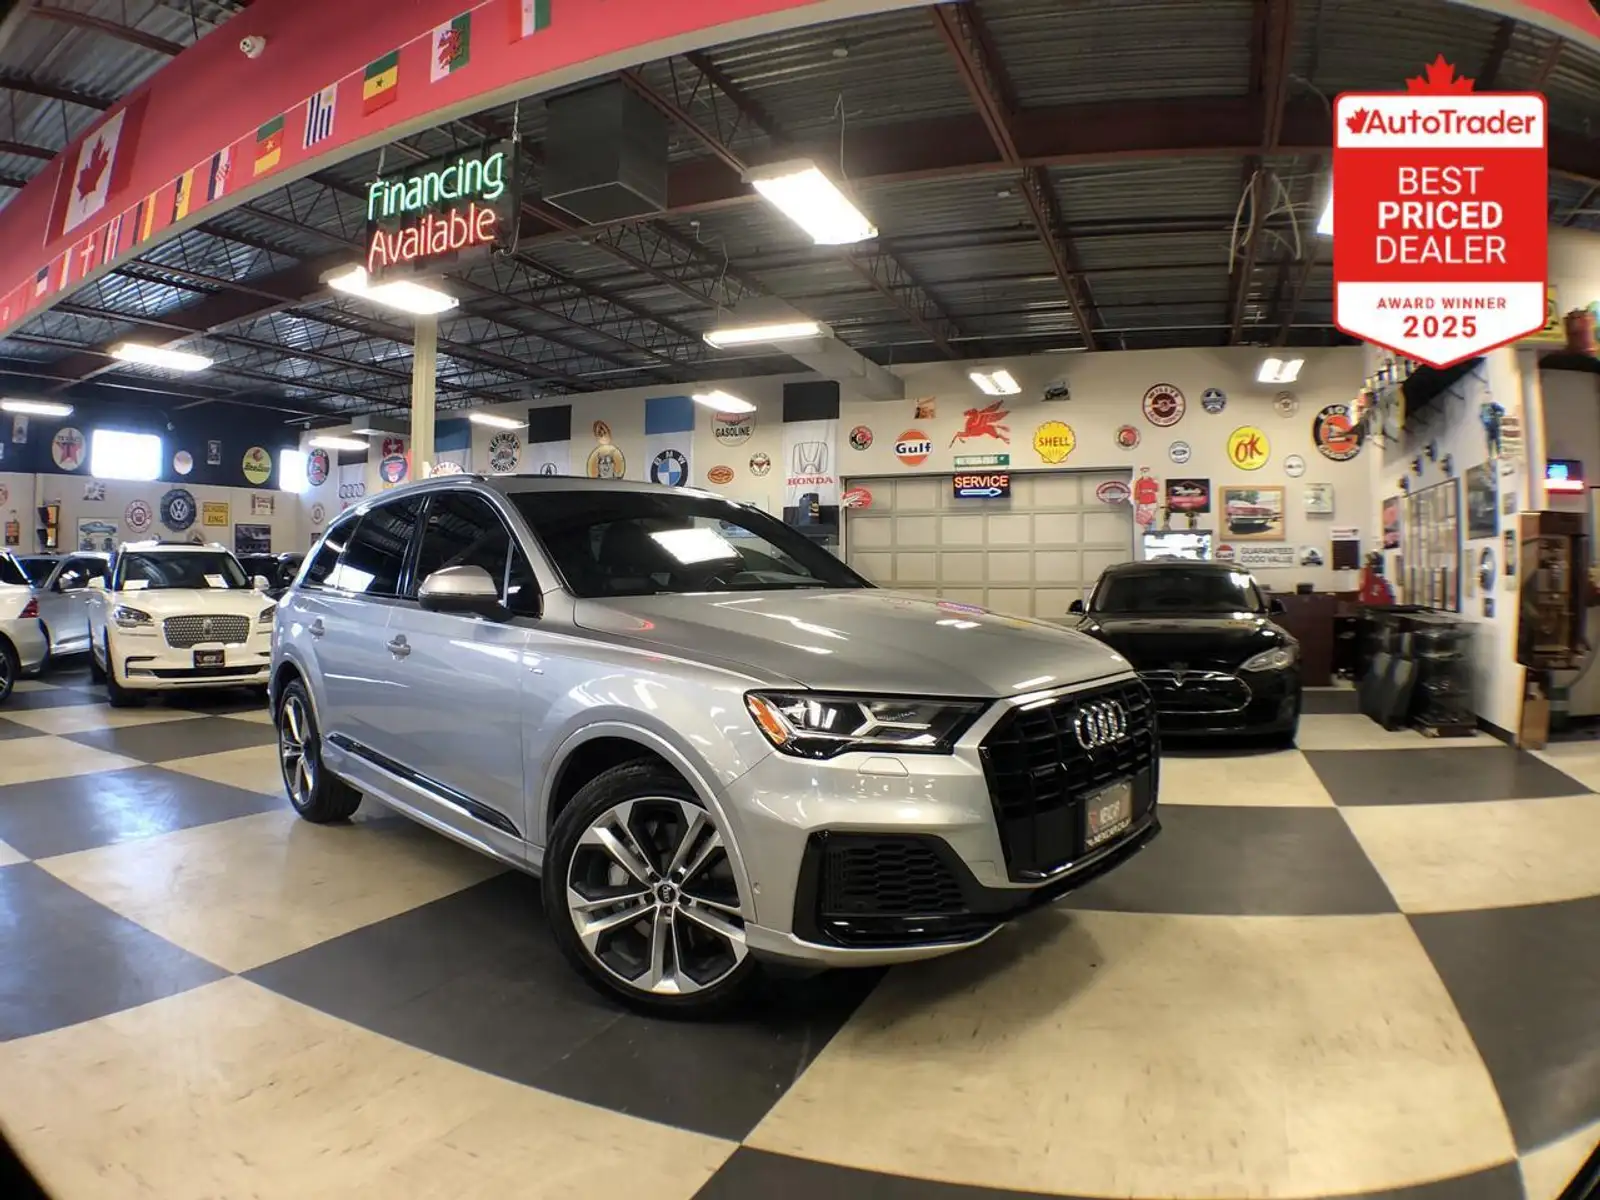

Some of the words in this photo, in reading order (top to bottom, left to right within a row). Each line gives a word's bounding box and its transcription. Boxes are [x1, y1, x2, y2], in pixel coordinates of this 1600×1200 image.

[368, 152, 504, 221] Financing
[368, 202, 496, 273] Available
[715, 427, 751, 438] GASOLINE
[895, 442, 932, 455] Gulf
[1037, 436, 1071, 448] SHELL
[1235, 432, 1264, 463] OK
[653, 450, 688, 467] BMW
[787, 476, 834, 486] HONDA
[954, 475, 1009, 488] SERVICE
[1240, 547, 1294, 555] GUARANTEED
